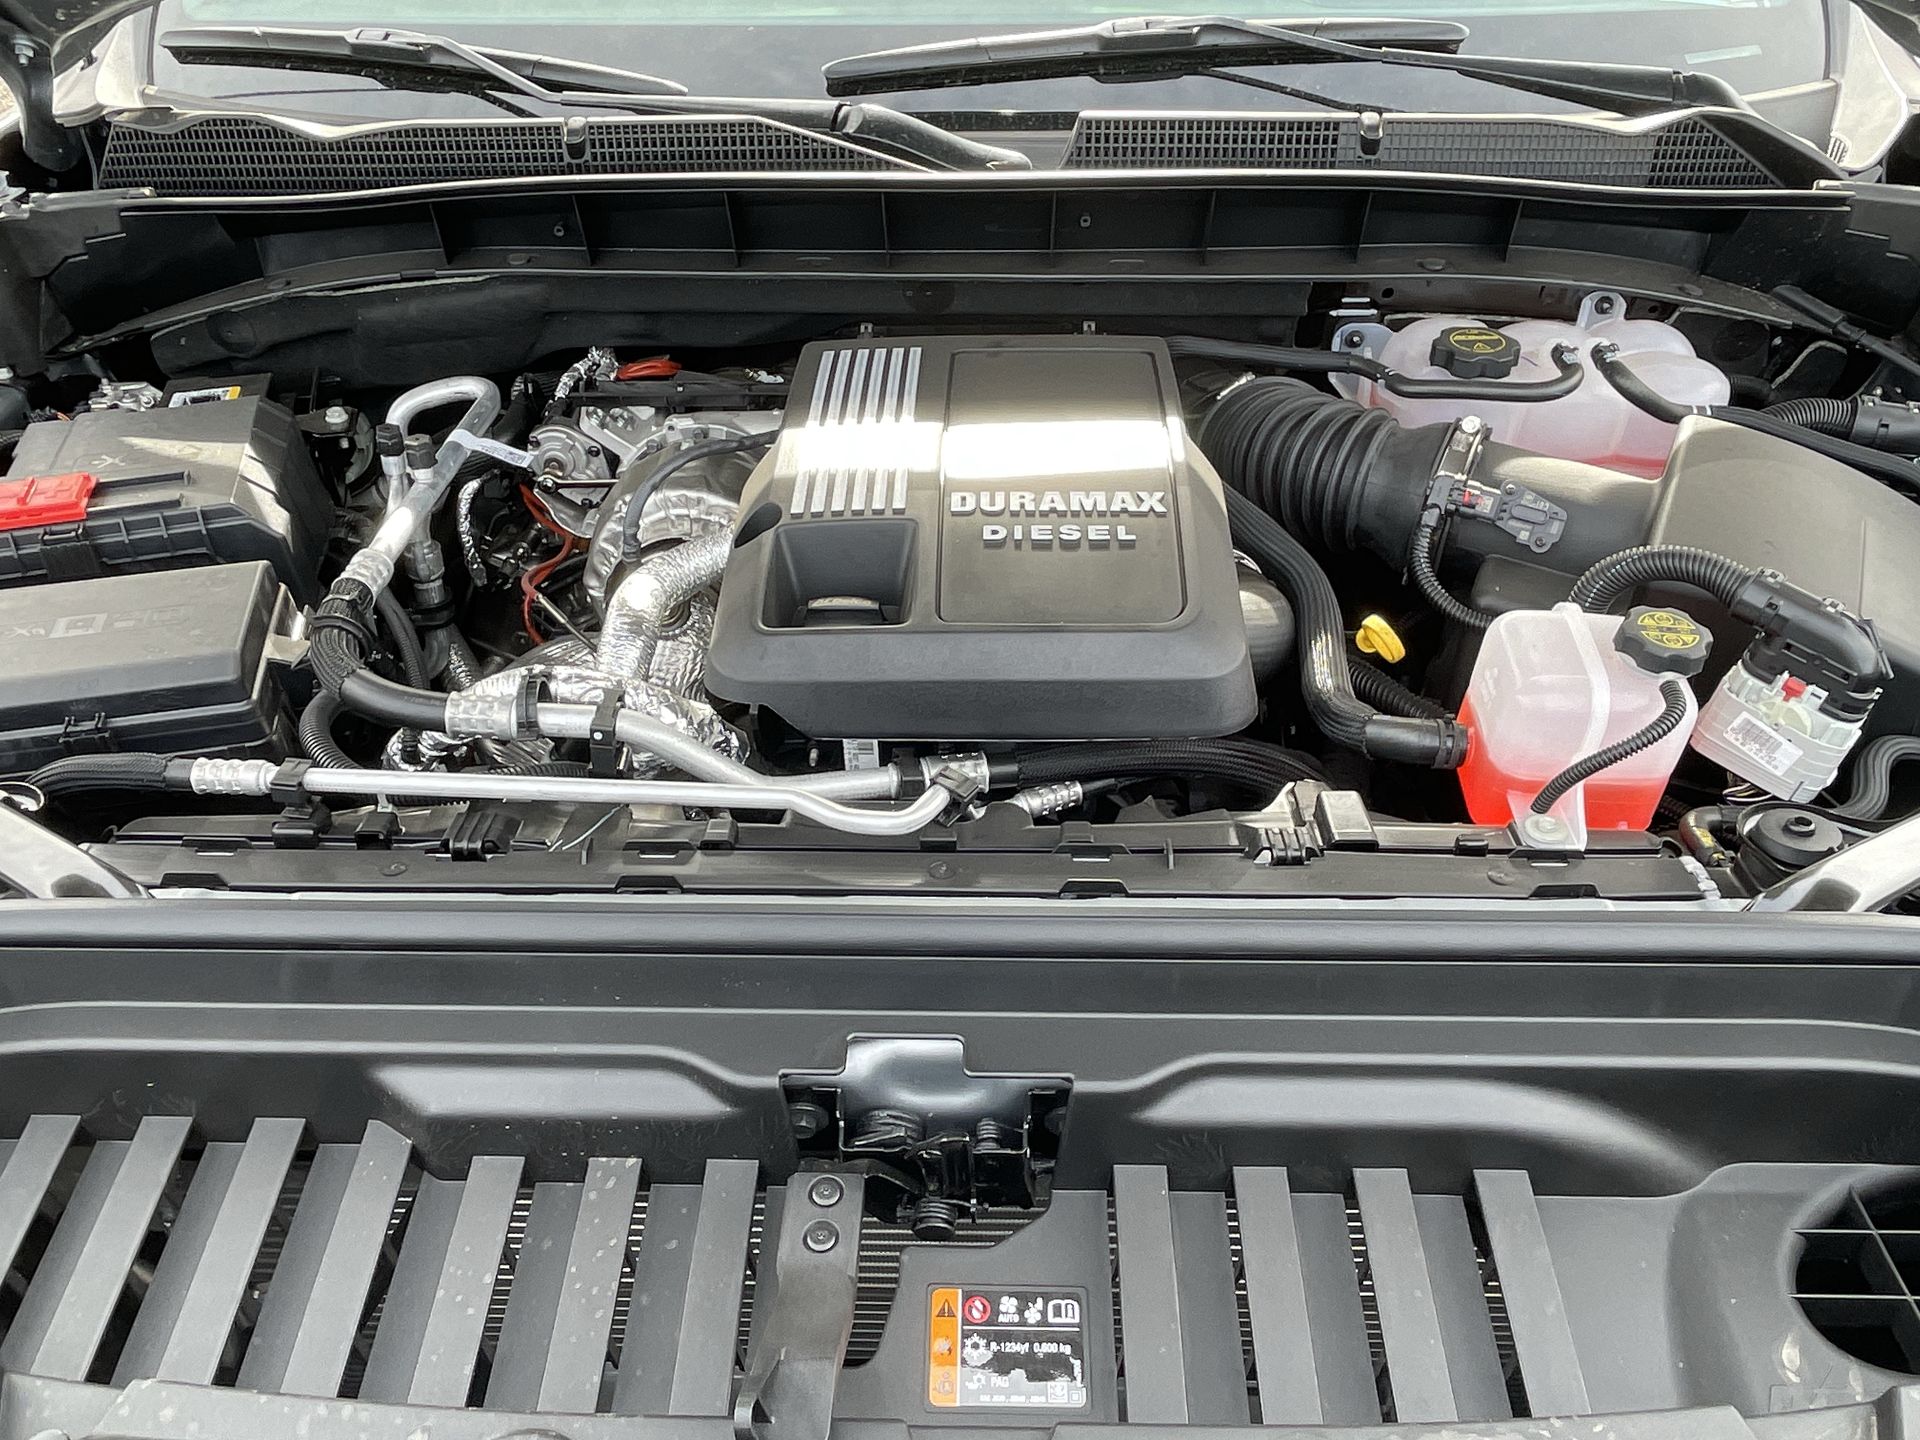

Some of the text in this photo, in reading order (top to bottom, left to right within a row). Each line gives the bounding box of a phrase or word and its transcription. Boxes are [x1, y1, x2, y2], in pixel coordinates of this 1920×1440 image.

[951, 491, 1167, 516] DURAMAX
[983, 524, 1137, 546] DIESEL
[998, 1313, 1019, 1323] AUTO
[990, 1341, 1030, 1355] R-1234yf
[1060, 1342, 1072, 1355] kg
